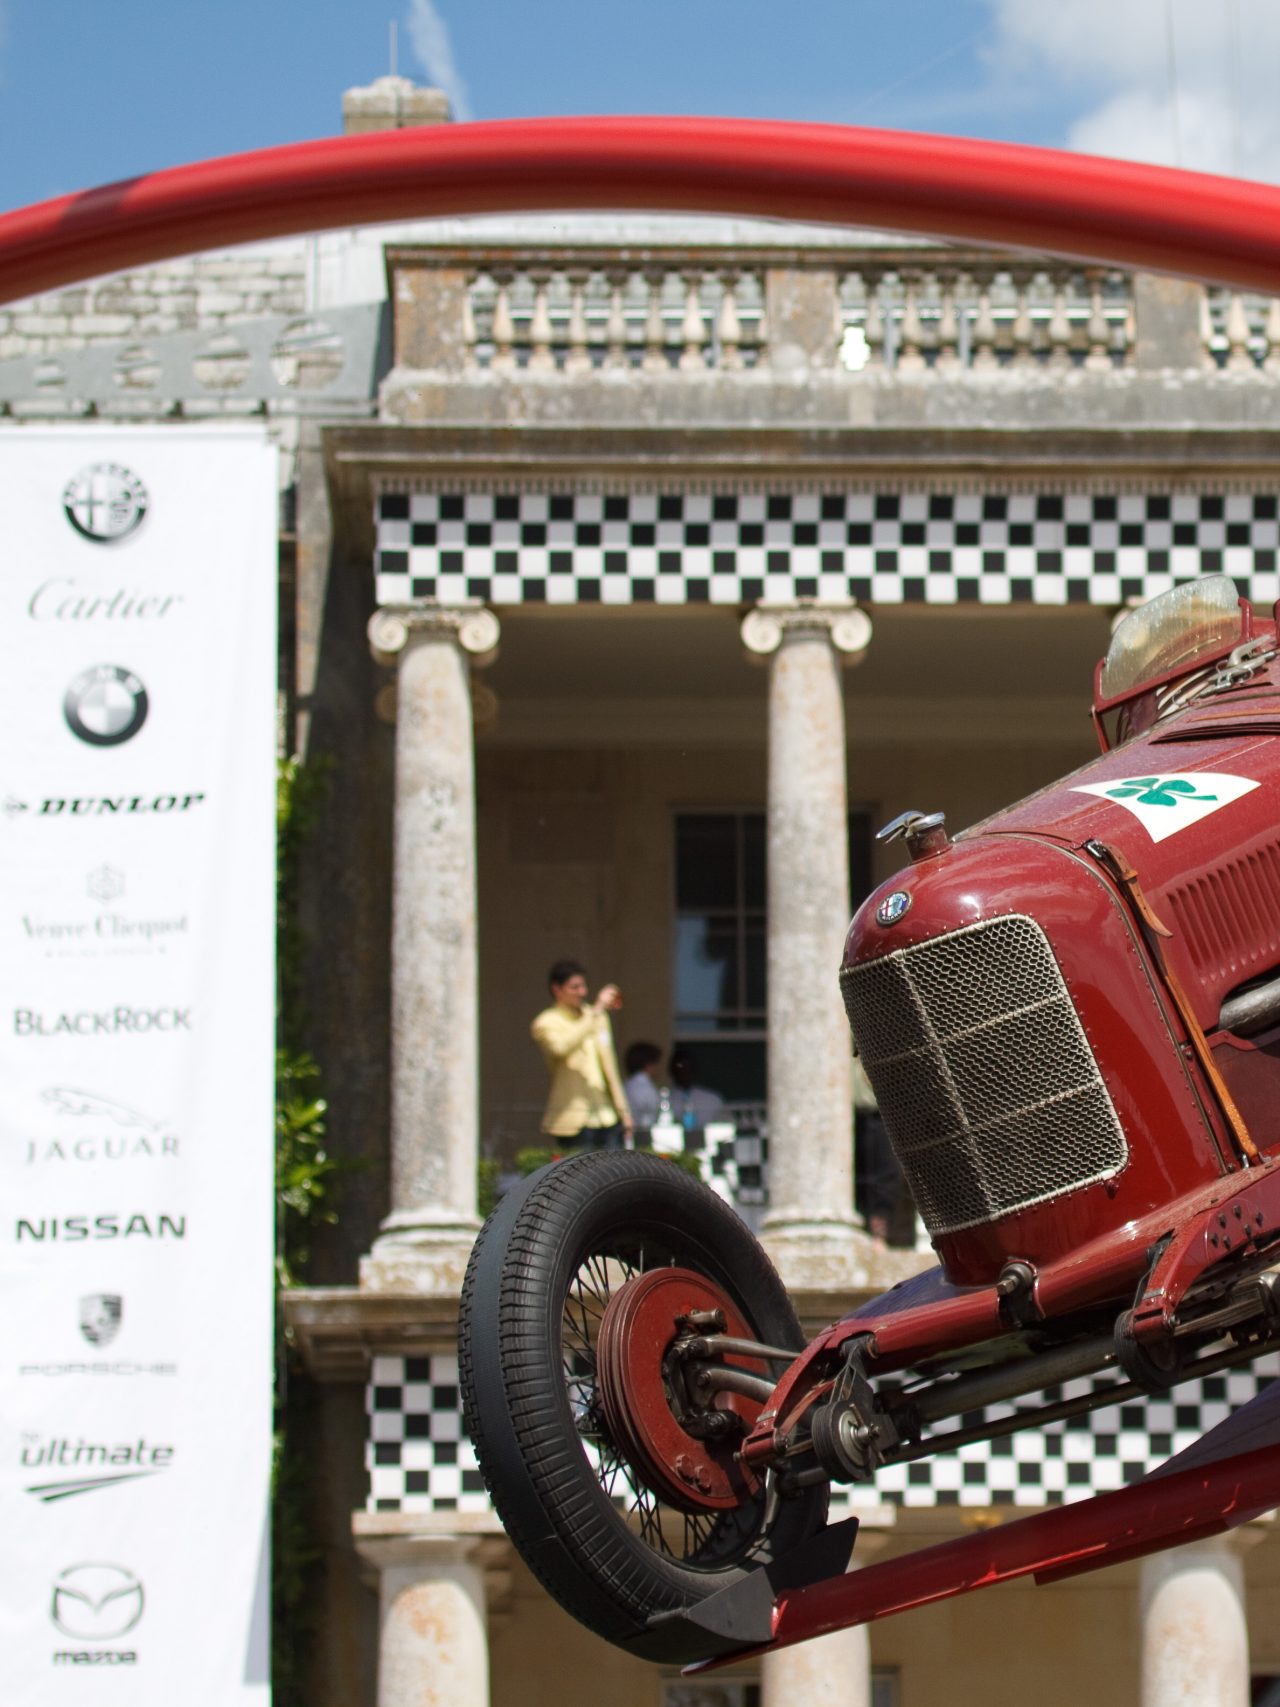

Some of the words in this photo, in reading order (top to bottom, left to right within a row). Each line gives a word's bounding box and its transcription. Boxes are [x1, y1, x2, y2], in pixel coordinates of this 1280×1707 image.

[27, 577, 184, 620] Cartier
[38, 793, 205, 816] DUNLOP
[26, 1137, 181, 1162] JAGUAR
[16, 1215, 187, 1241] NISSAN
[19, 1437, 175, 1467] ultimate
